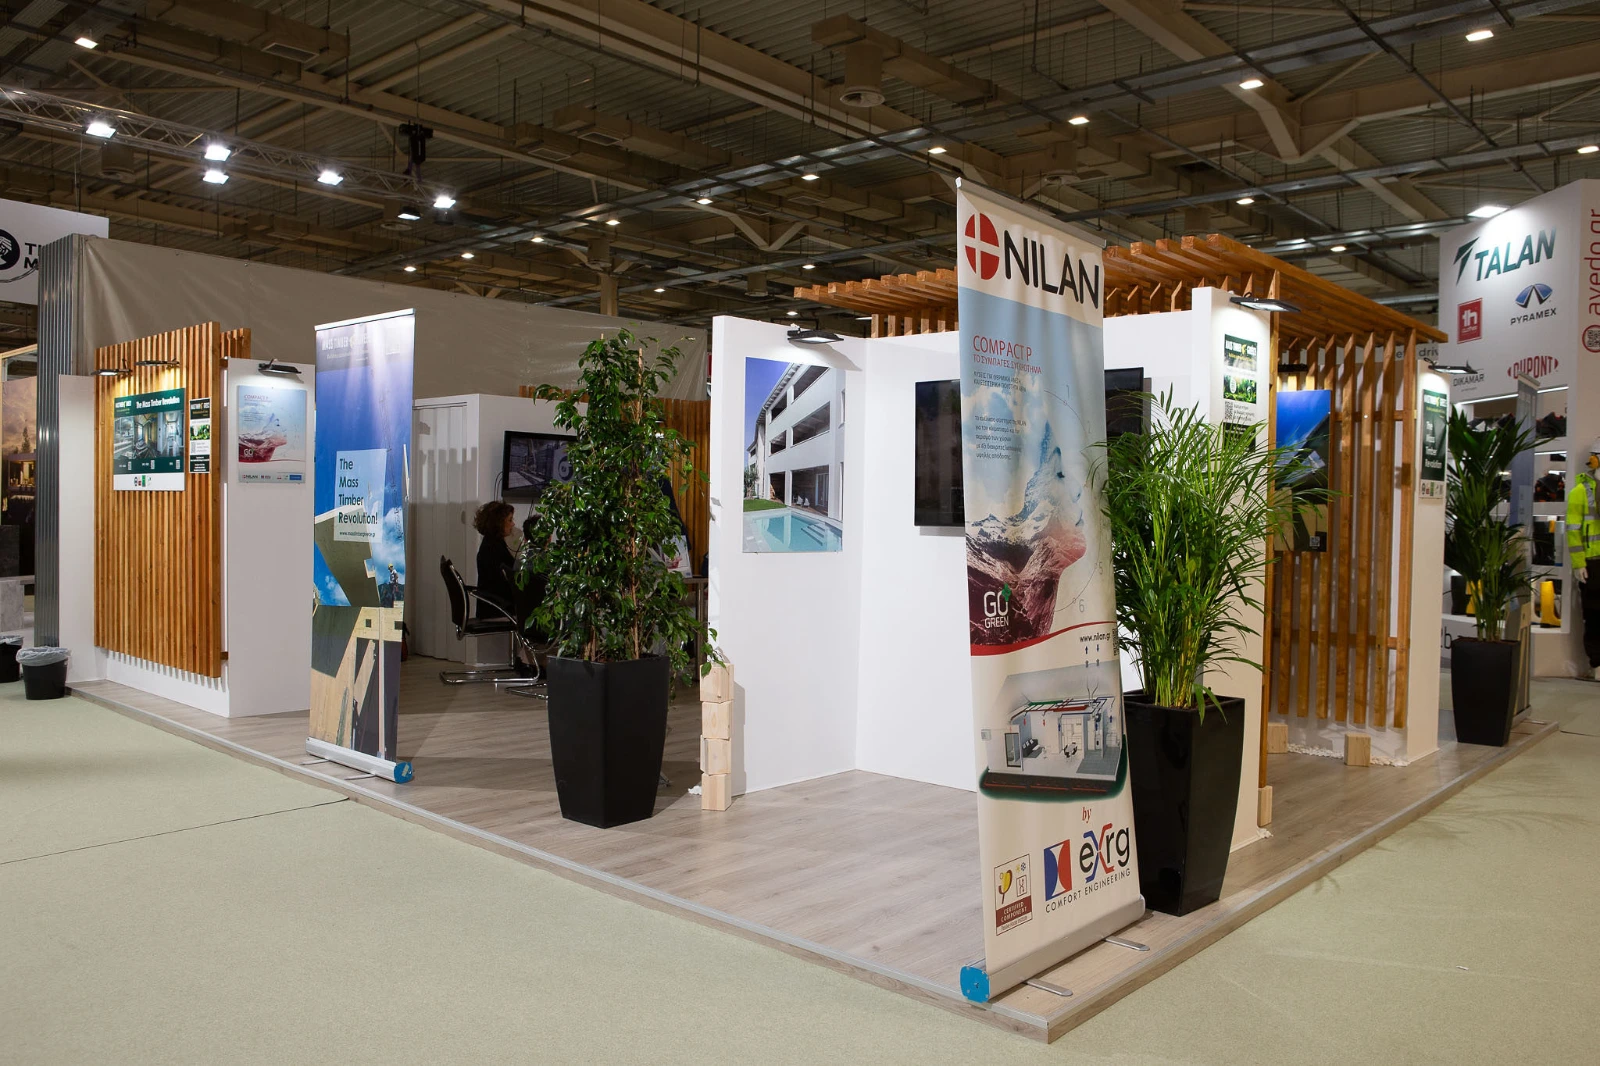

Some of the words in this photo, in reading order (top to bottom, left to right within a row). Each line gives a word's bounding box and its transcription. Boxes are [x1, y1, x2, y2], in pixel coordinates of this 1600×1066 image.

[1475, 226, 1557, 282] TALAN
[1004, 229, 1099, 309] NILAN
[1510, 307, 1557, 326] PYRAMEX
[973, 335, 1025, 360] COMPACT
[1026, 346, 1032, 361] P
[1453, 374, 1484, 387] DIKAMAR
[339, 458, 354, 470] The
[338, 476, 359, 488] Mass
[338, 494, 364, 506] Timber
[338, 512, 378, 525] Revolution!
[984, 591, 1009, 618] GO
[1078, 599, 1085, 613] 6
[984, 616, 1010, 629] GREEN
[1082, 806, 1092, 824] by
[1045, 890, 1082, 914] COMFORT
[1084, 868, 1131, 896] ENGINEERING
[1000, 906, 1027, 923] COMPONENT
[1003, 901, 1024, 915] CERTIFIED
